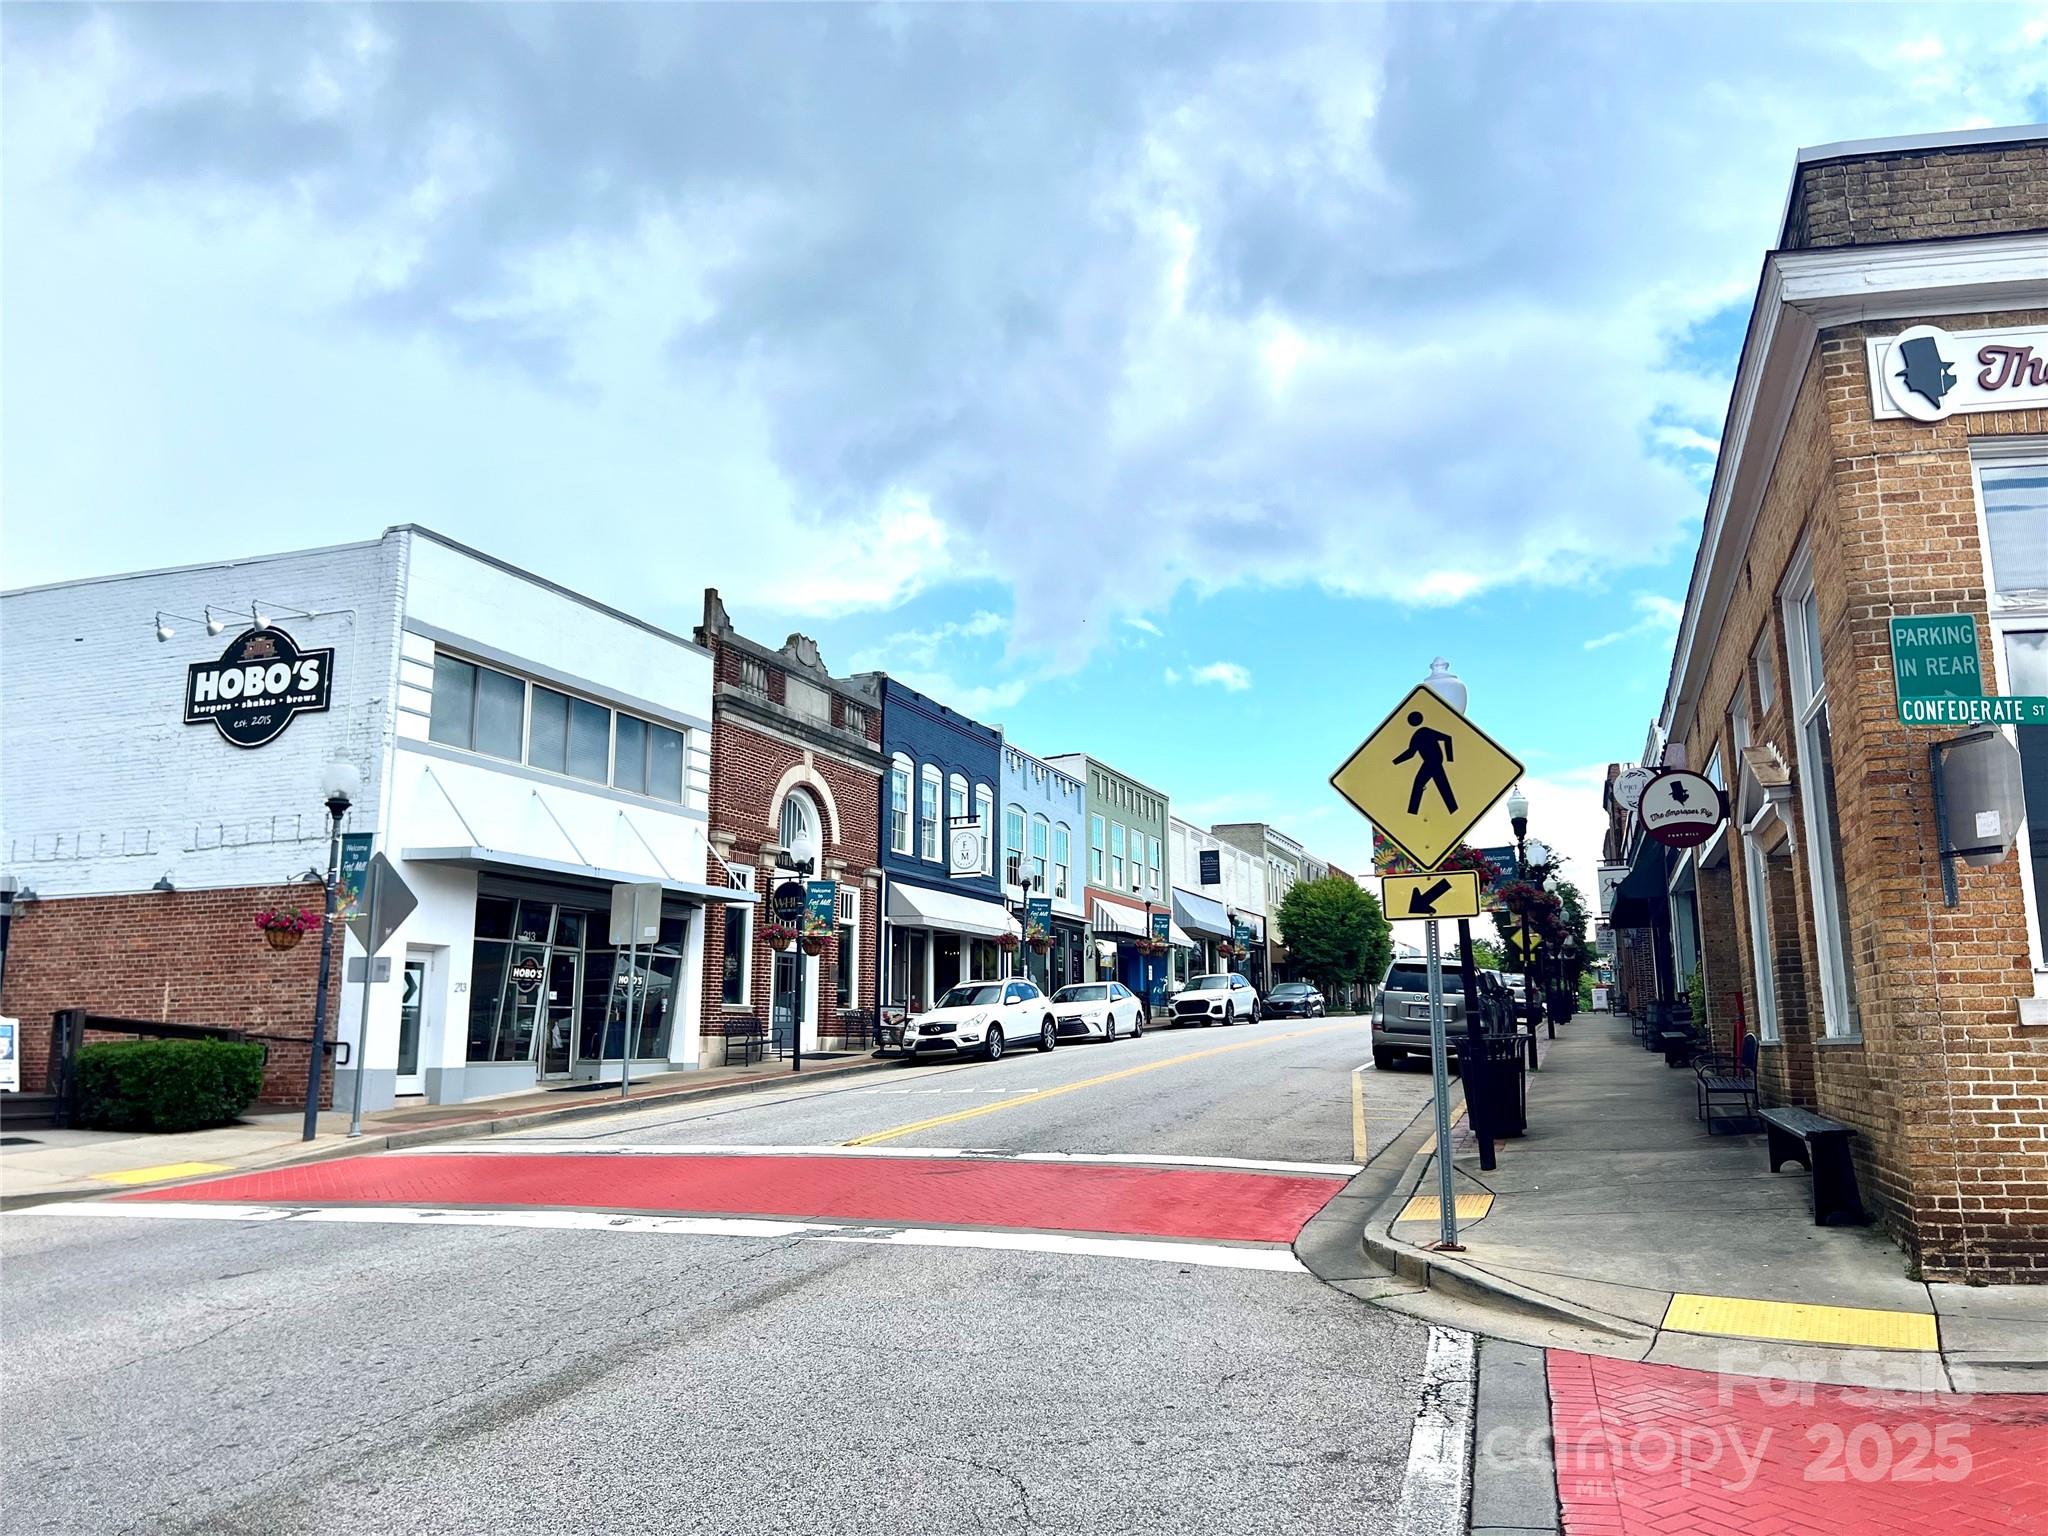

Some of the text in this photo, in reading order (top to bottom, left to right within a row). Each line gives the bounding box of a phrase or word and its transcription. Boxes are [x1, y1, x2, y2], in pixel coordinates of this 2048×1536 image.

[1895, 625, 1973, 647] PARKING
[1900, 655, 1976, 677] IN REAR
[194, 659, 320, 702] HOBO'S
[193, 702, 232, 714] burgers
[241, 698, 276, 709] shakes
[1902, 700, 2046, 721] CONFEDERATE ST
[1650, 807, 1713, 822] The Improper Pig
[513, 967, 543, 980] HOBO'S
